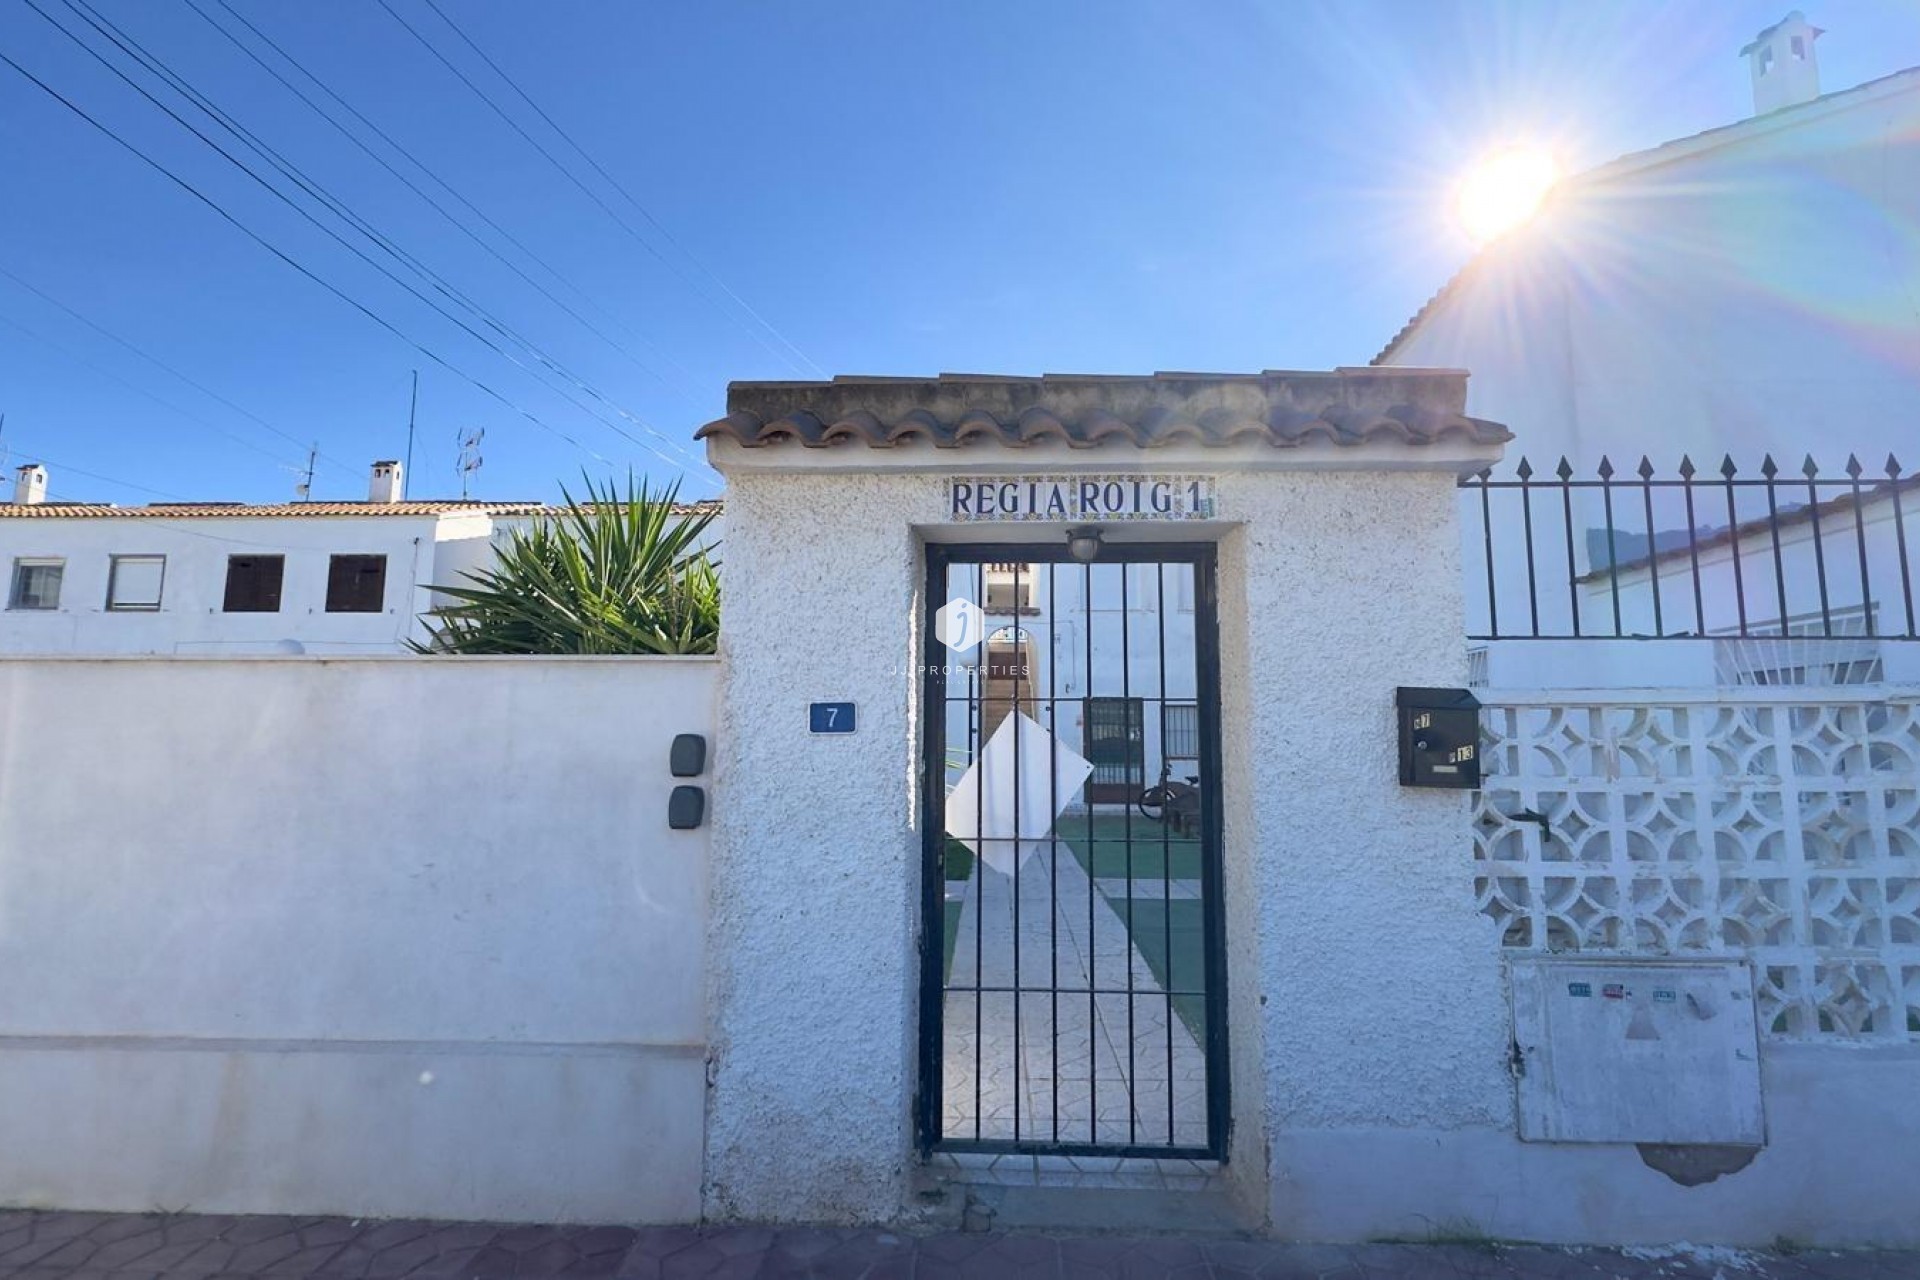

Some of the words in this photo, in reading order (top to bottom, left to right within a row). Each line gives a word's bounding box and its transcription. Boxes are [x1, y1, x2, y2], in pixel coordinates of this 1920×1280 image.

[952, 482, 1066, 514] REGIA
[1080, 481, 1173, 514] ROIG
[1186, 481, 1200, 512] 1
[826, 707, 838, 728] 7
